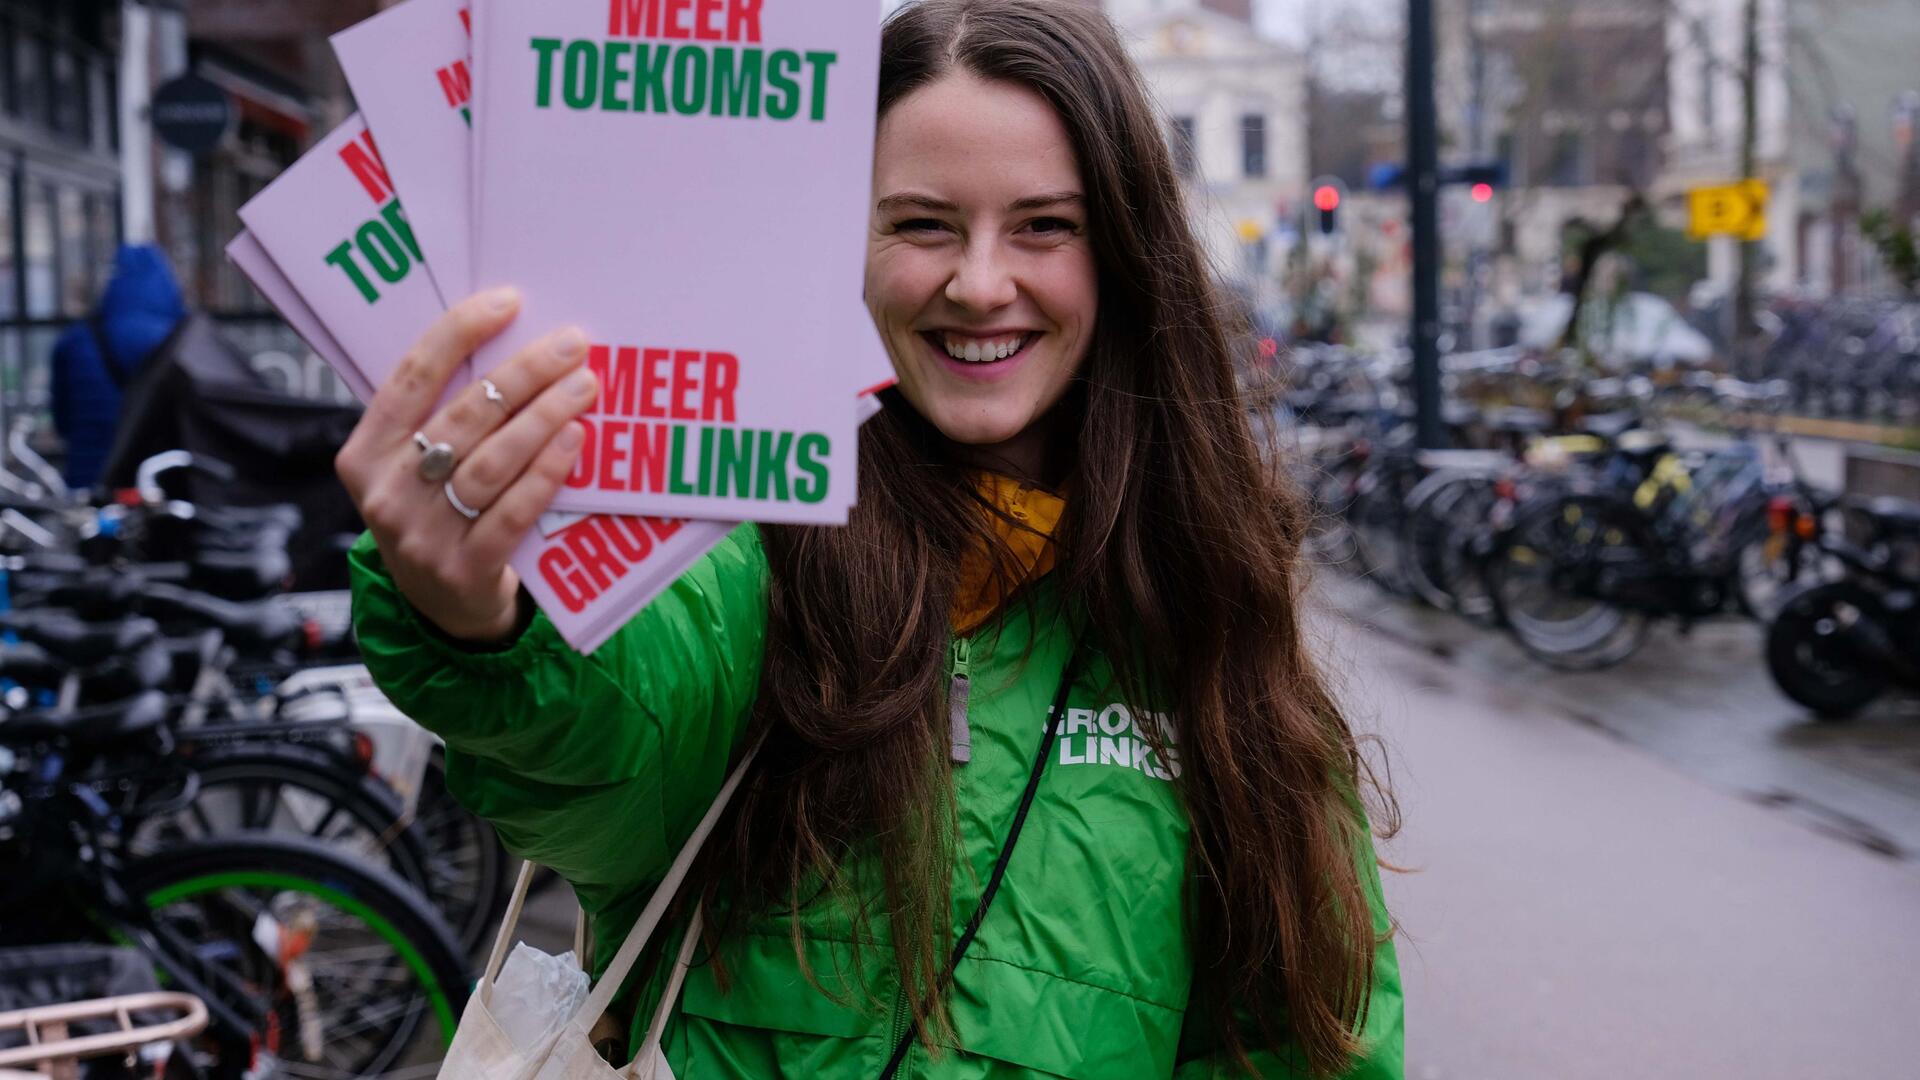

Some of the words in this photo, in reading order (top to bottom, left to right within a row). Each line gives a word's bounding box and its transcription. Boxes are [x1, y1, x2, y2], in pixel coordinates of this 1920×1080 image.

[608, 0, 764, 43] MEER
[531, 37, 837, 120] TOEKOMST
[584, 345, 740, 423] MEER
[1059, 736, 1183, 781] LINKS
